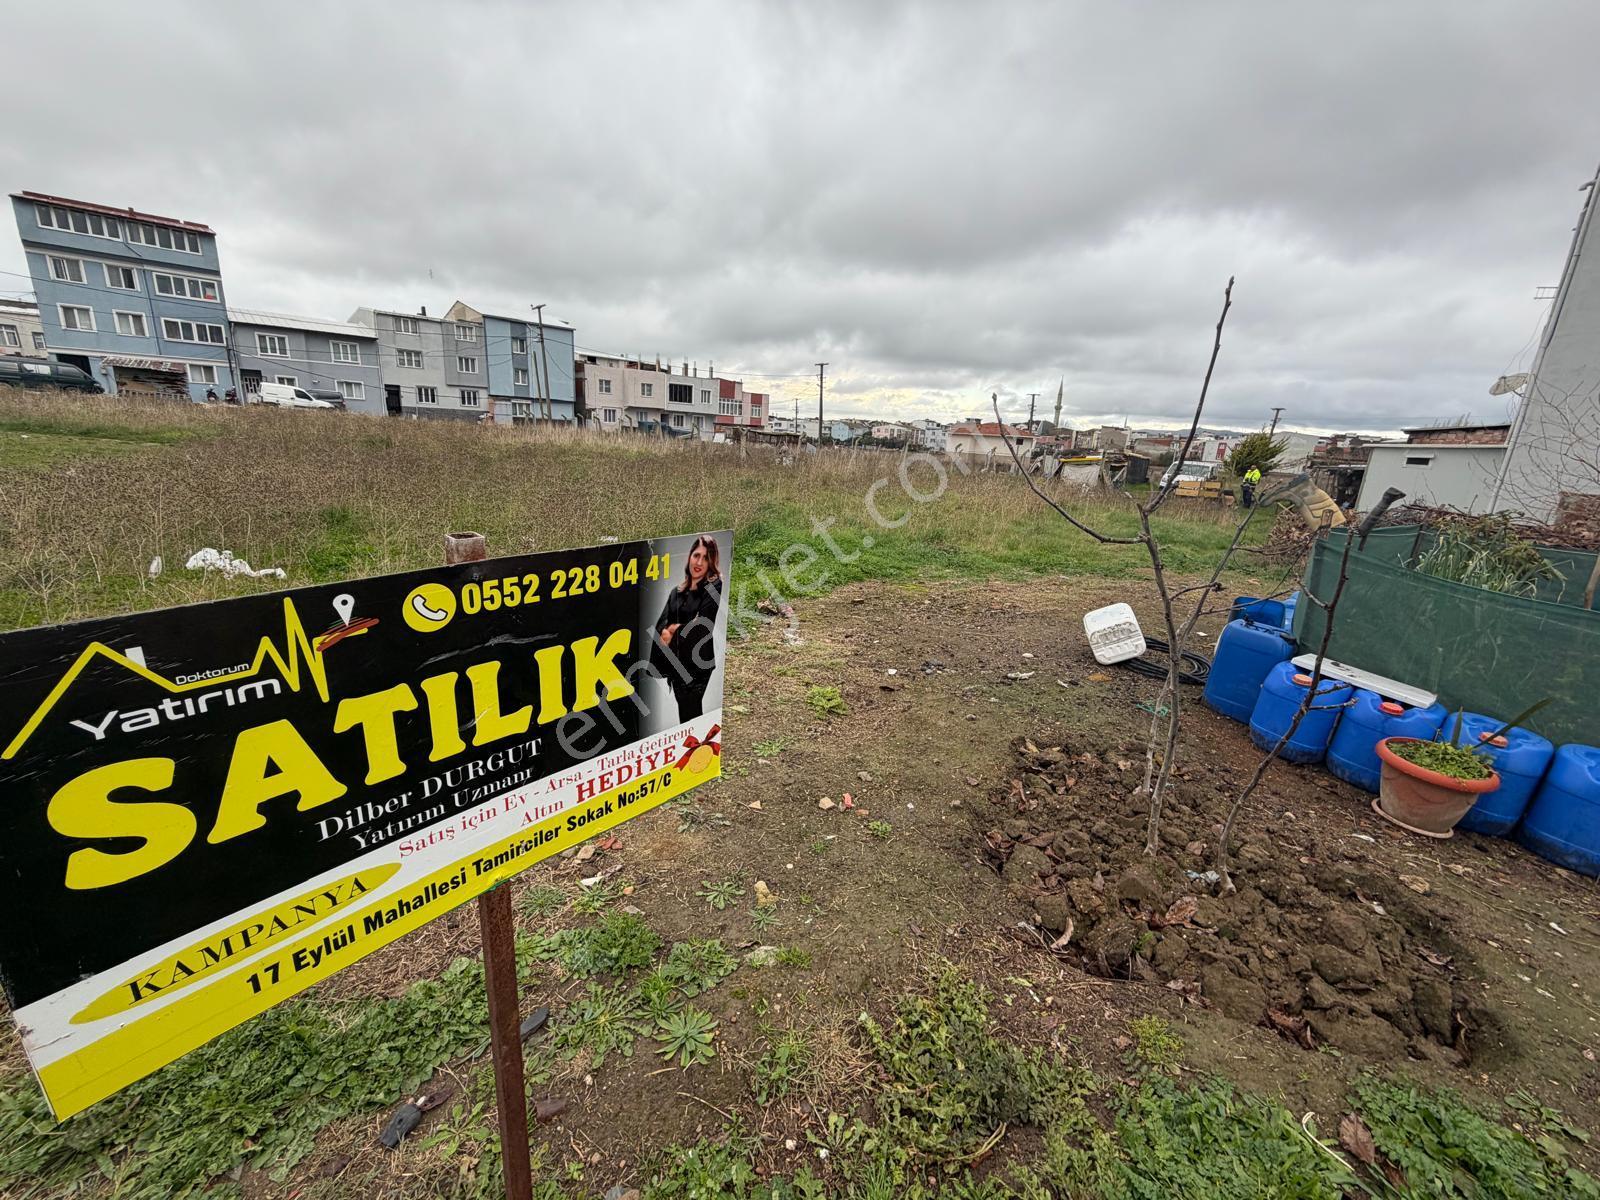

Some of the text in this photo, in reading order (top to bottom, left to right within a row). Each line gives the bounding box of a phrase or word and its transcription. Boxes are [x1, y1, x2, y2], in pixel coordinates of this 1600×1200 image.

[461, 552, 670, 615] 0552 228 04 41
[69, 678, 282, 741] Yatırım
[175, 662, 250, 685] Doktorum
[47, 628, 636, 890] SATILIK
[314, 738, 543, 843] Dilber DURGUT
[398, 824, 455, 859] Satış
[460, 807, 498, 831] için
[503, 793, 528, 815] Ev
[546, 770, 583, 796] Arsa
[597, 749, 635, 771] Tarla
[639, 726, 695, 755] Getirene
[350, 766, 534, 851] Yatırım Uzmanı
[521, 799, 564, 828] Altın
[246, 772, 672, 994] 17 Eylül Mahallesi Tamirciler Sokak No:57/C
[121, 876, 371, 1006] KAMPANYA
